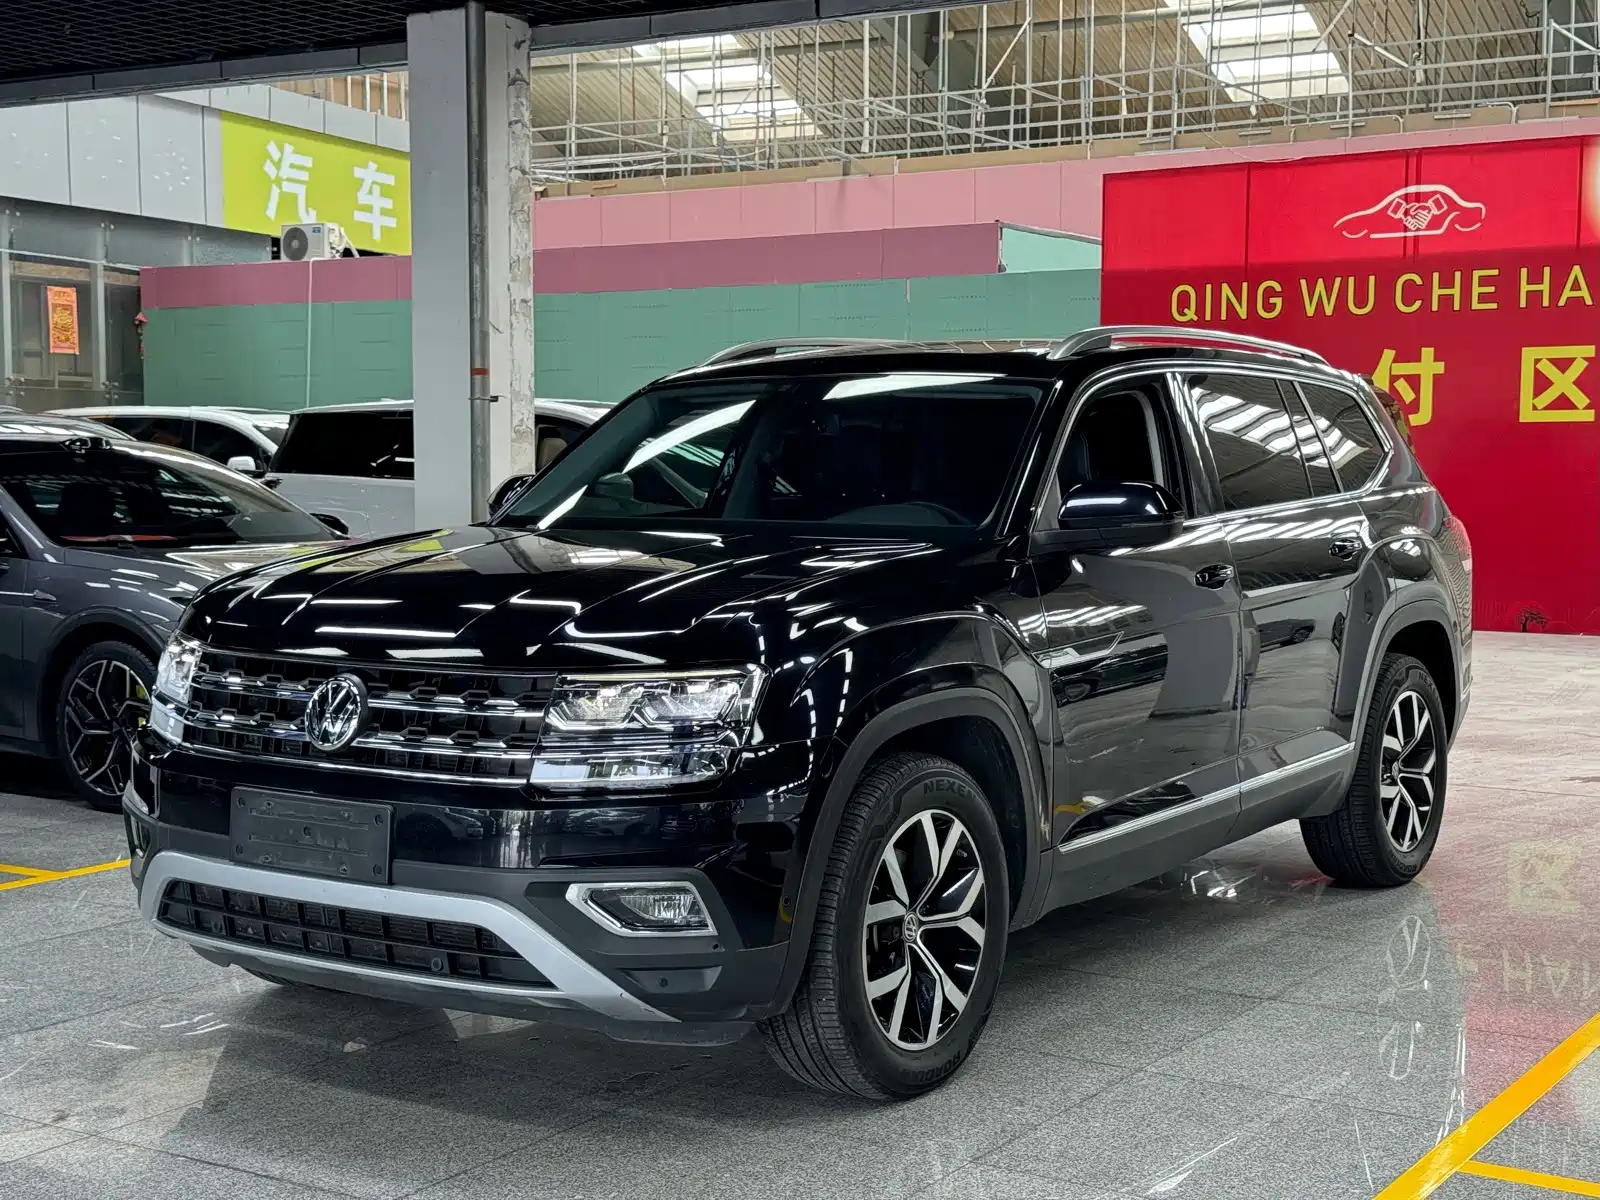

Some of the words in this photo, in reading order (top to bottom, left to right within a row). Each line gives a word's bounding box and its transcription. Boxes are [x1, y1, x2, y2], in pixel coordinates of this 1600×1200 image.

[263, 139, 397, 241] 汽车
[1171, 280, 1284, 322] QING
[1300, 275, 1376, 318] WU
[1394, 269, 1500, 313] CHE
[1518, 264, 1594, 308] HA
